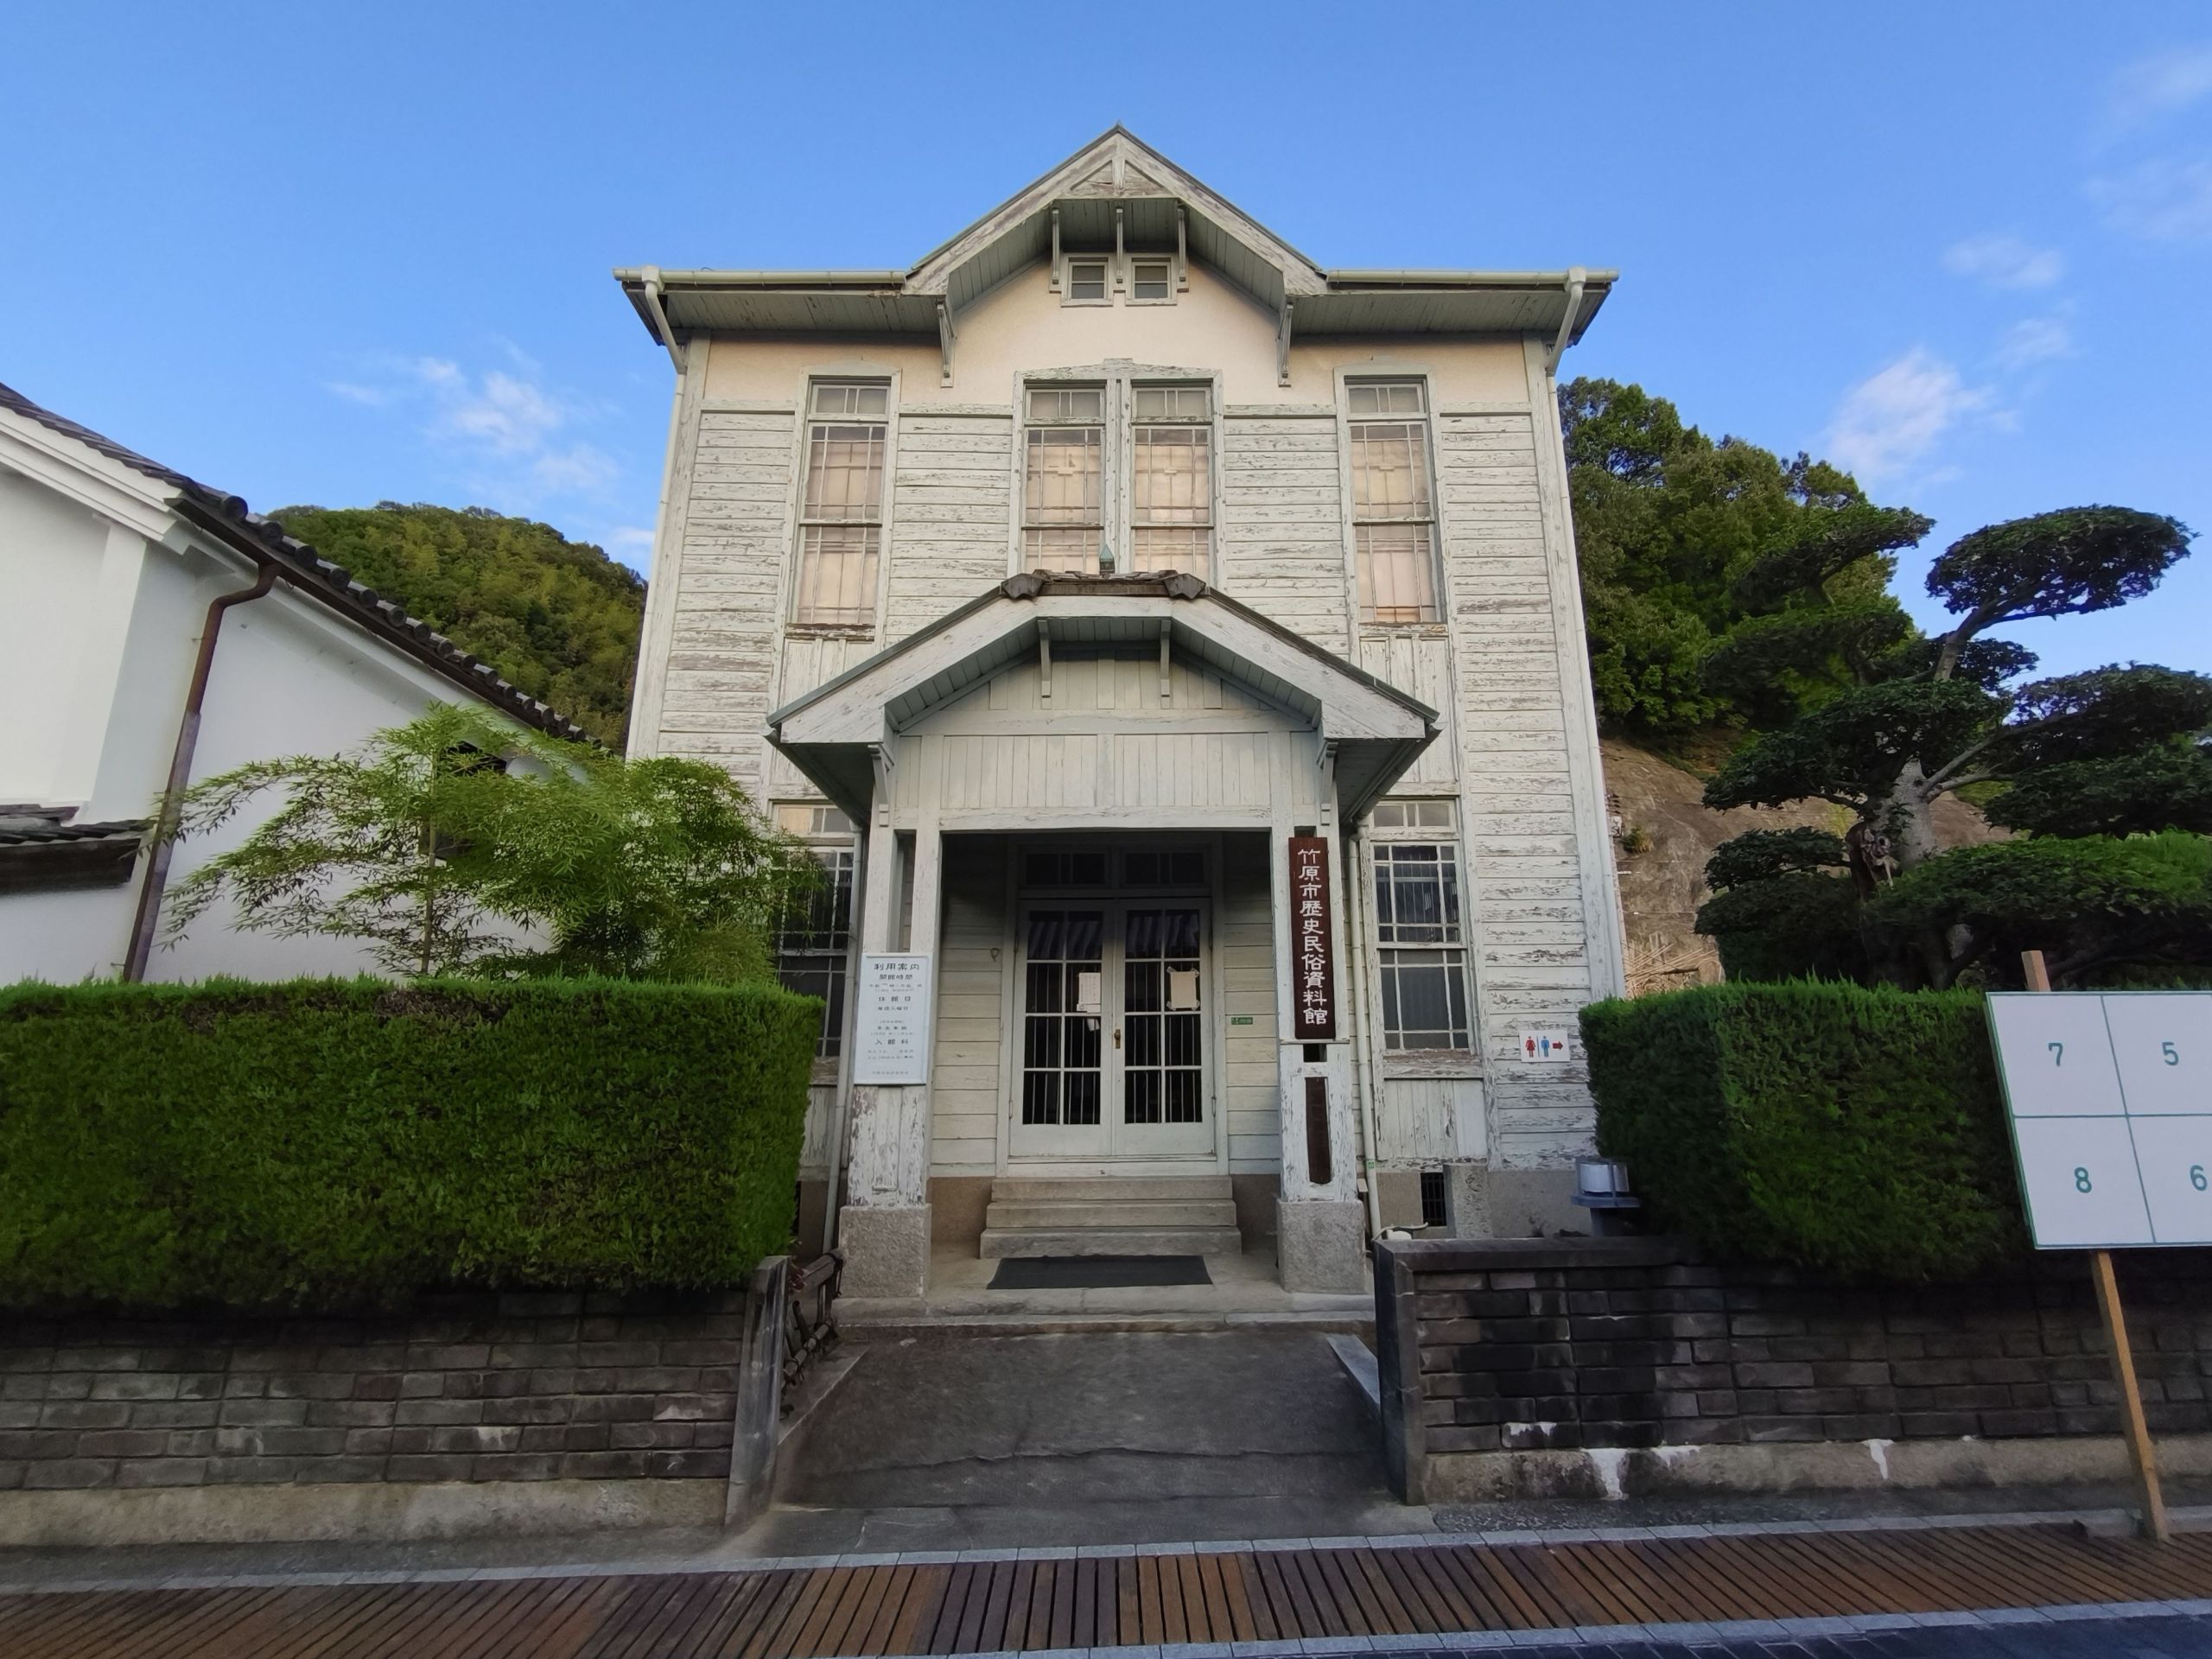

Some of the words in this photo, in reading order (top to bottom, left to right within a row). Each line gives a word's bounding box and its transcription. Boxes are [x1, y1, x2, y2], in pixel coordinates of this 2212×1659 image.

[1297, 849, 1328, 1025] 竹原市歴史民俗資料館
[2048, 1042, 2064, 1066] 7
[2161, 1041, 2180, 1066] 5
[2074, 1166, 2093, 1193] 8
[2190, 1165, 2208, 1192] 6
